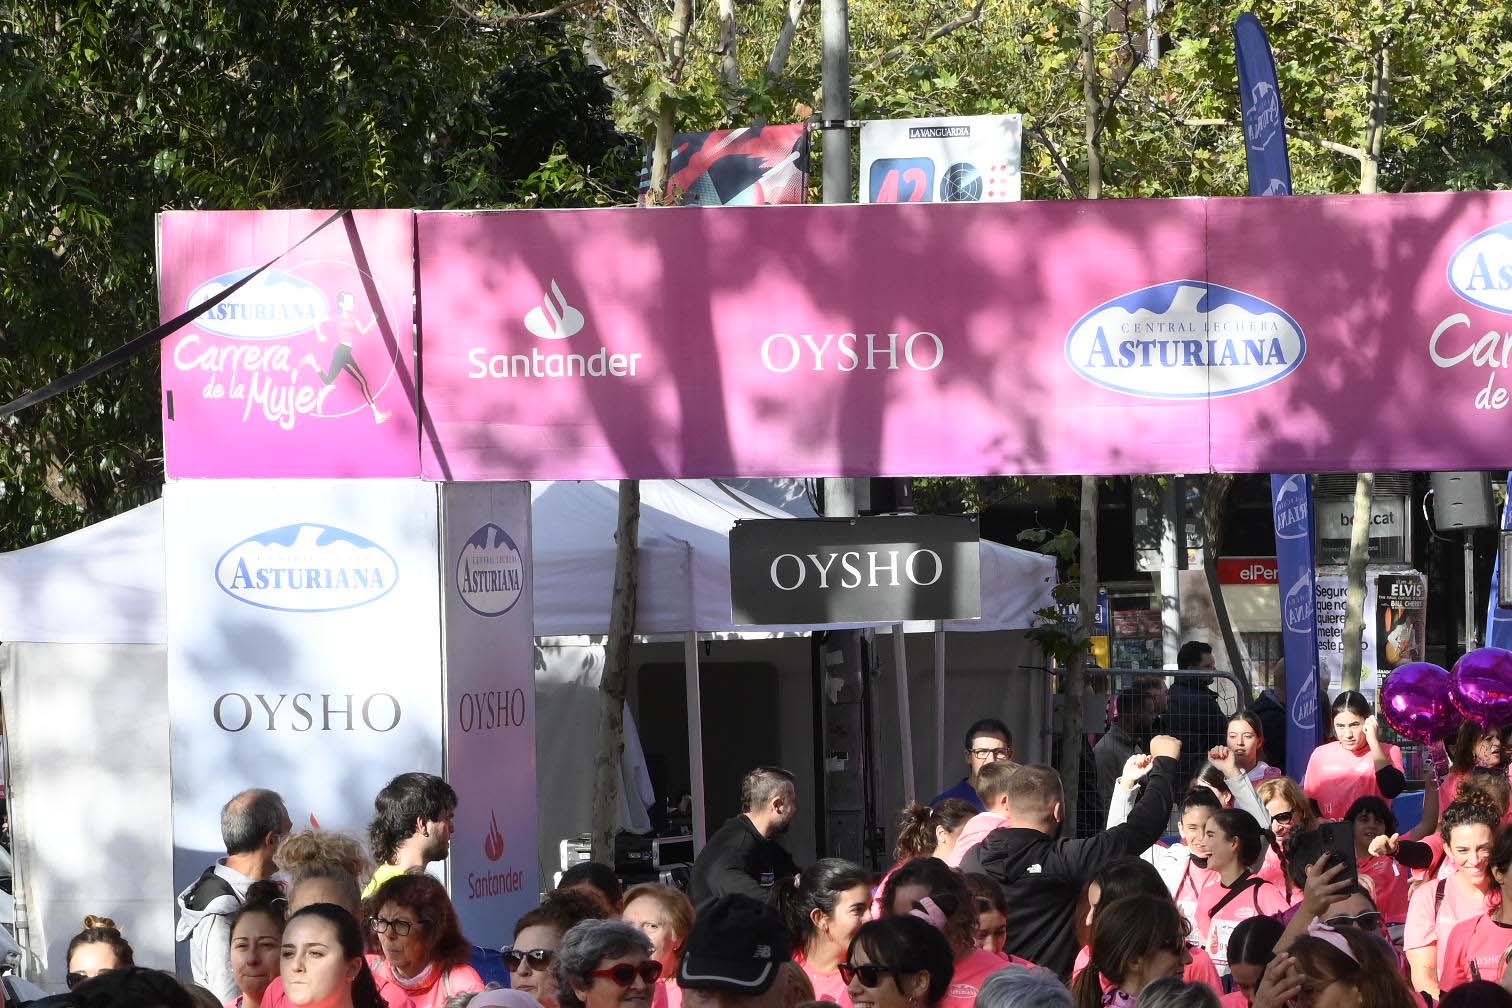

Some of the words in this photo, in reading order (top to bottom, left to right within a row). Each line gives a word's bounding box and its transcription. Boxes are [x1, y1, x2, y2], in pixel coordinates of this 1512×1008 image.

[1121, 321, 1196, 334] CENTRAL
[1203, 319, 1279, 332] LECHERA
[174, 333, 291, 371] Carrera
[468, 347, 642, 378] Santander
[760, 331, 944, 372] OYSHO
[1084, 325, 1288, 368] ASTURIANA
[203, 374, 225, 400] de
[228, 373, 246, 400] la
[242, 367, 337, 431] Mujer
[1474, 371, 1510, 411] de
[230, 556, 386, 592] ASTURIANA
[461, 564, 522, 594] ASTURIANA
[769, 549, 944, 591] OYSHO
[1317, 601, 1333, 614] que
[1391, 584, 1422, 597] ELVIS
[212, 692, 403, 733] OYSHO
[459, 687, 526, 733] OYSHO
[468, 867, 524, 899] Santander
